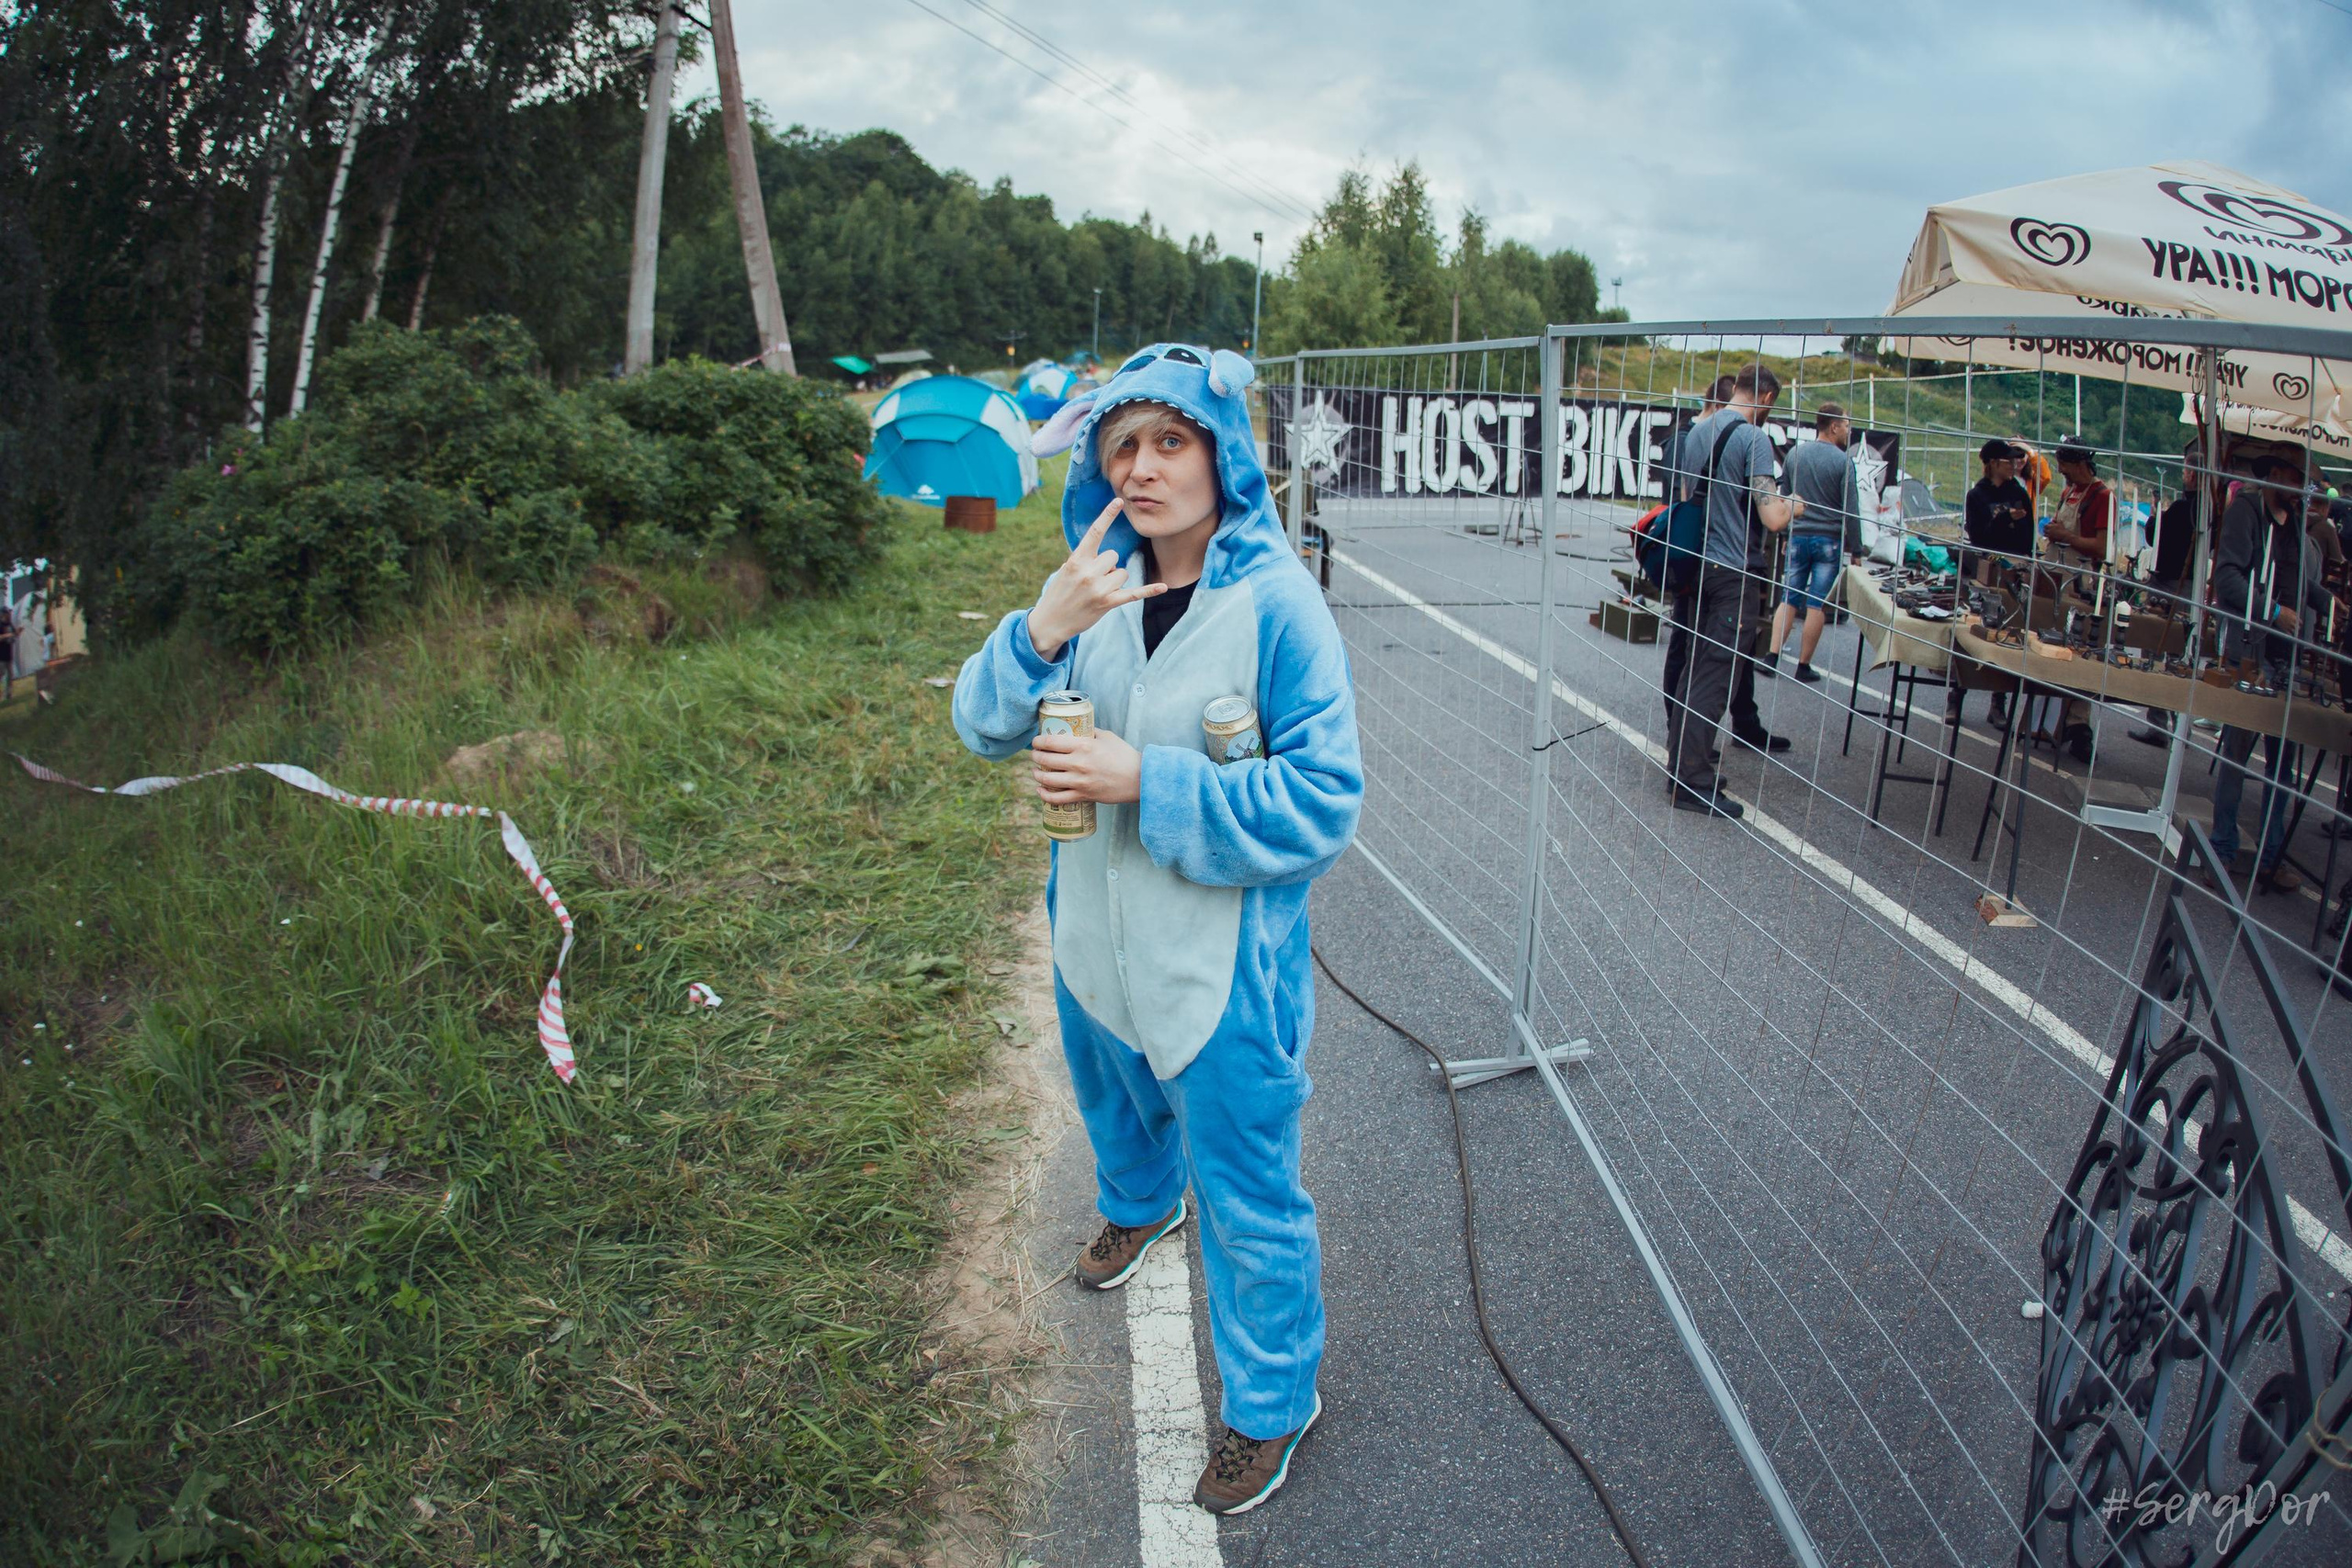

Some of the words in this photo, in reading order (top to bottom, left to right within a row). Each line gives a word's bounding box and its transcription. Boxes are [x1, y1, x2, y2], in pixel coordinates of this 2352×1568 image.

[2141, 236, 2260, 296] УРА!!!
[1380, 396, 1535, 494] HOST
[1556, 404, 1672, 499] BIKE
